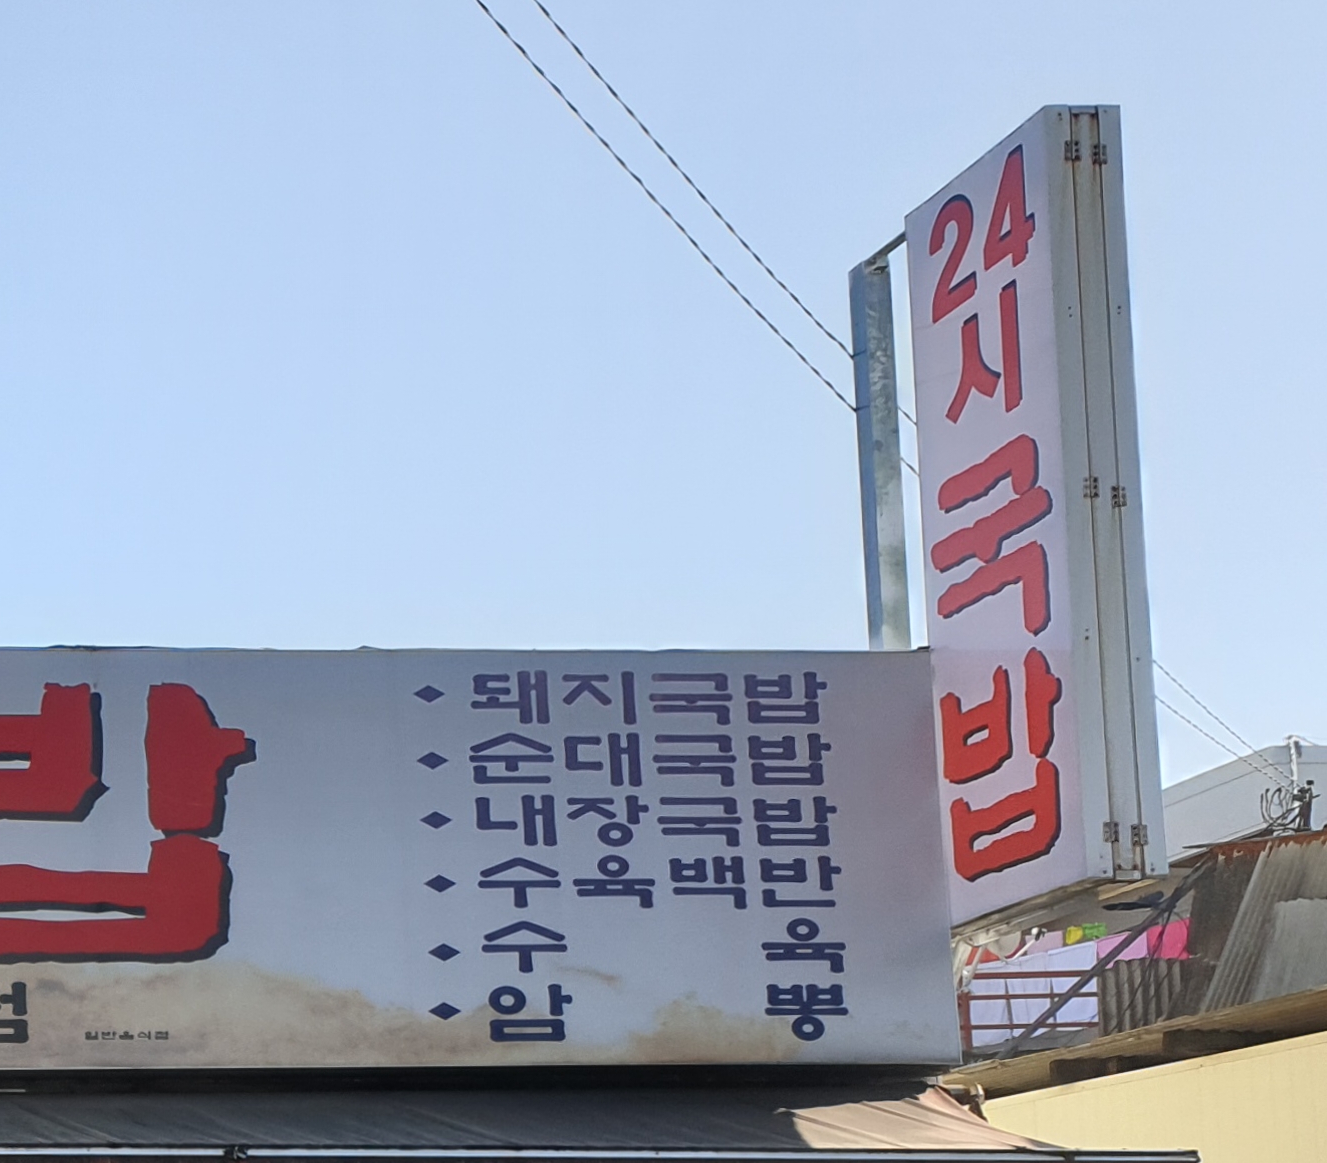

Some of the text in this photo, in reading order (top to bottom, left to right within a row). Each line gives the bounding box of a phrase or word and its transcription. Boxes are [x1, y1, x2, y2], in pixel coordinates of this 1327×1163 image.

[470, 670, 827, 725] 돼지국밥
[468, 732, 832, 787] 순대국밥
[474, 794, 838, 847] 내장국밥
[477, 855, 842, 909] 수육백반
